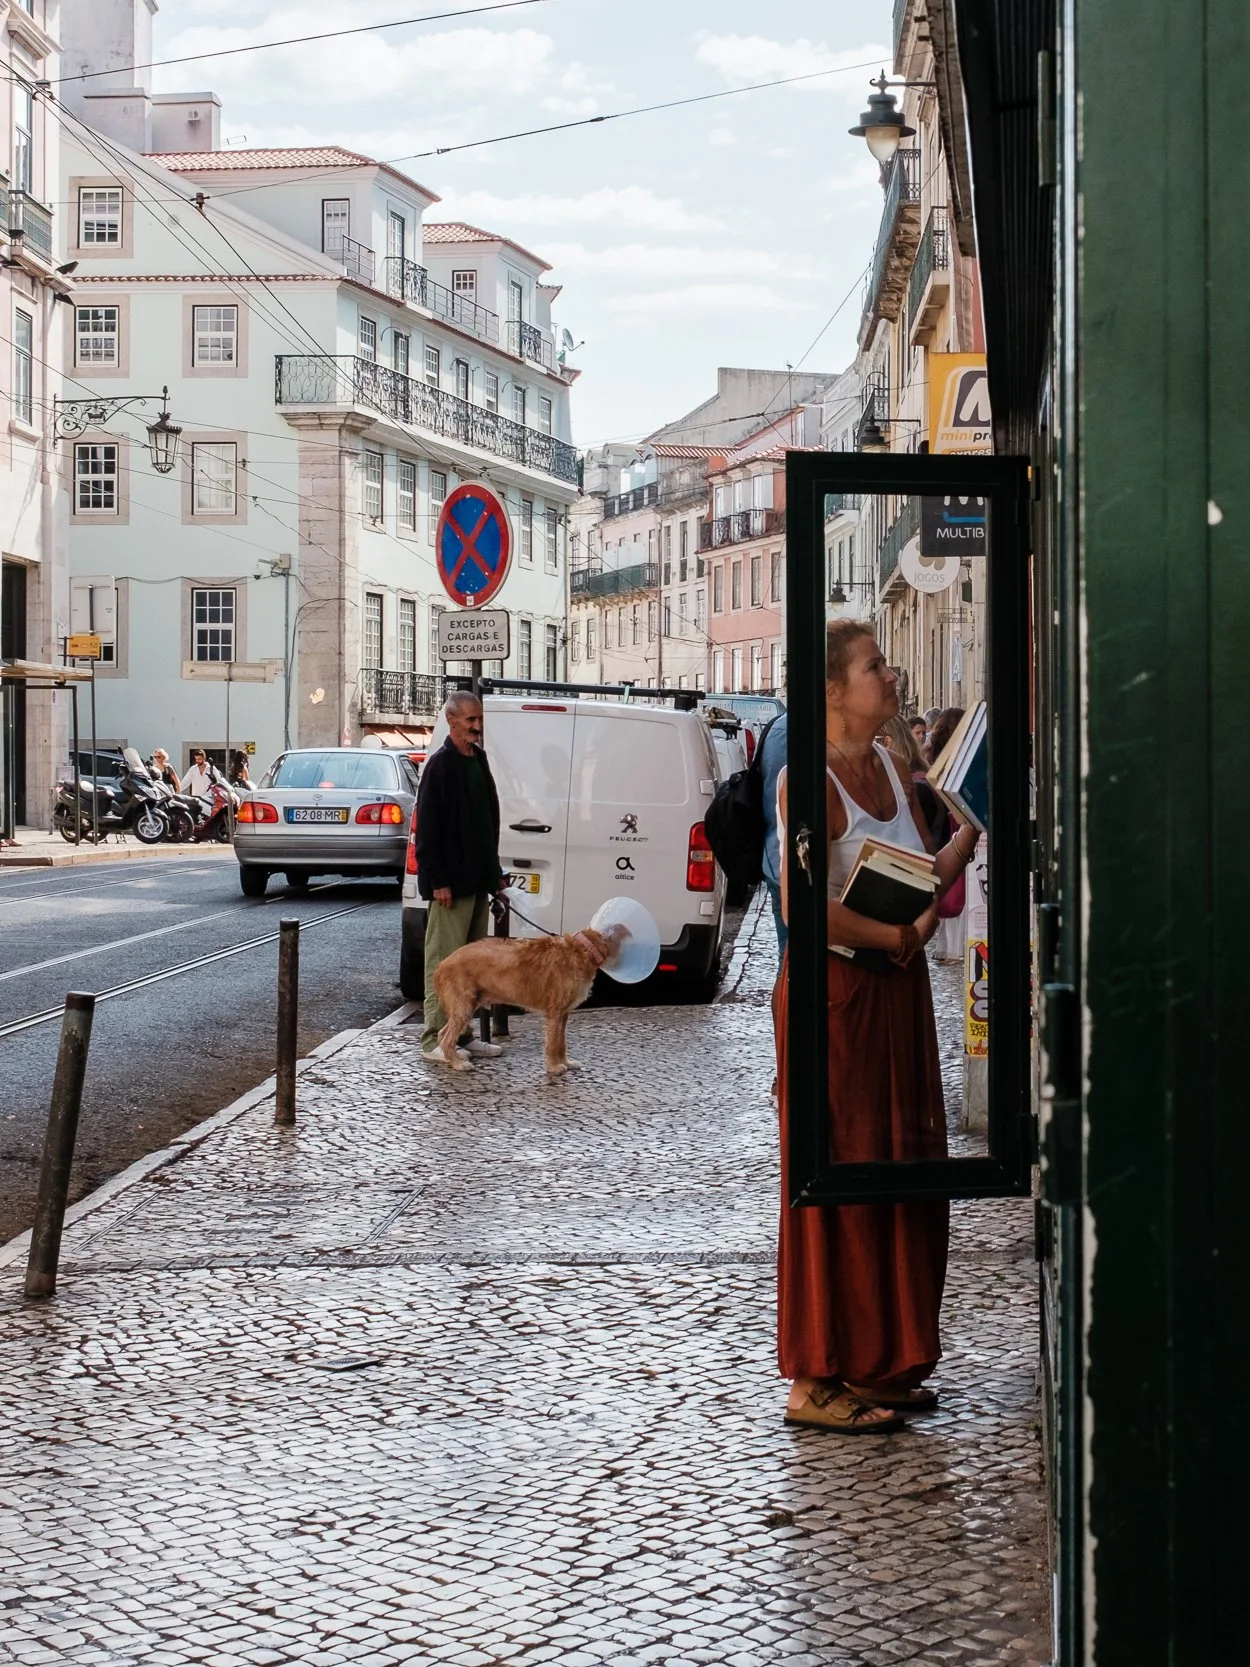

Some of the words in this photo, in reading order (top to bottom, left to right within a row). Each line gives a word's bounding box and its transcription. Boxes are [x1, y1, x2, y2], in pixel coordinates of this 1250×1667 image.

[941, 429, 992, 443] minipr
[936, 527, 985, 539] MULTIB
[914, 572, 945, 584] JOGOS
[450, 619, 495, 629] EXCEPTO
[447, 632, 489, 641] CARGAS
[493, 631, 499, 640] E
[442, 643, 504, 653] DESCARGAS
